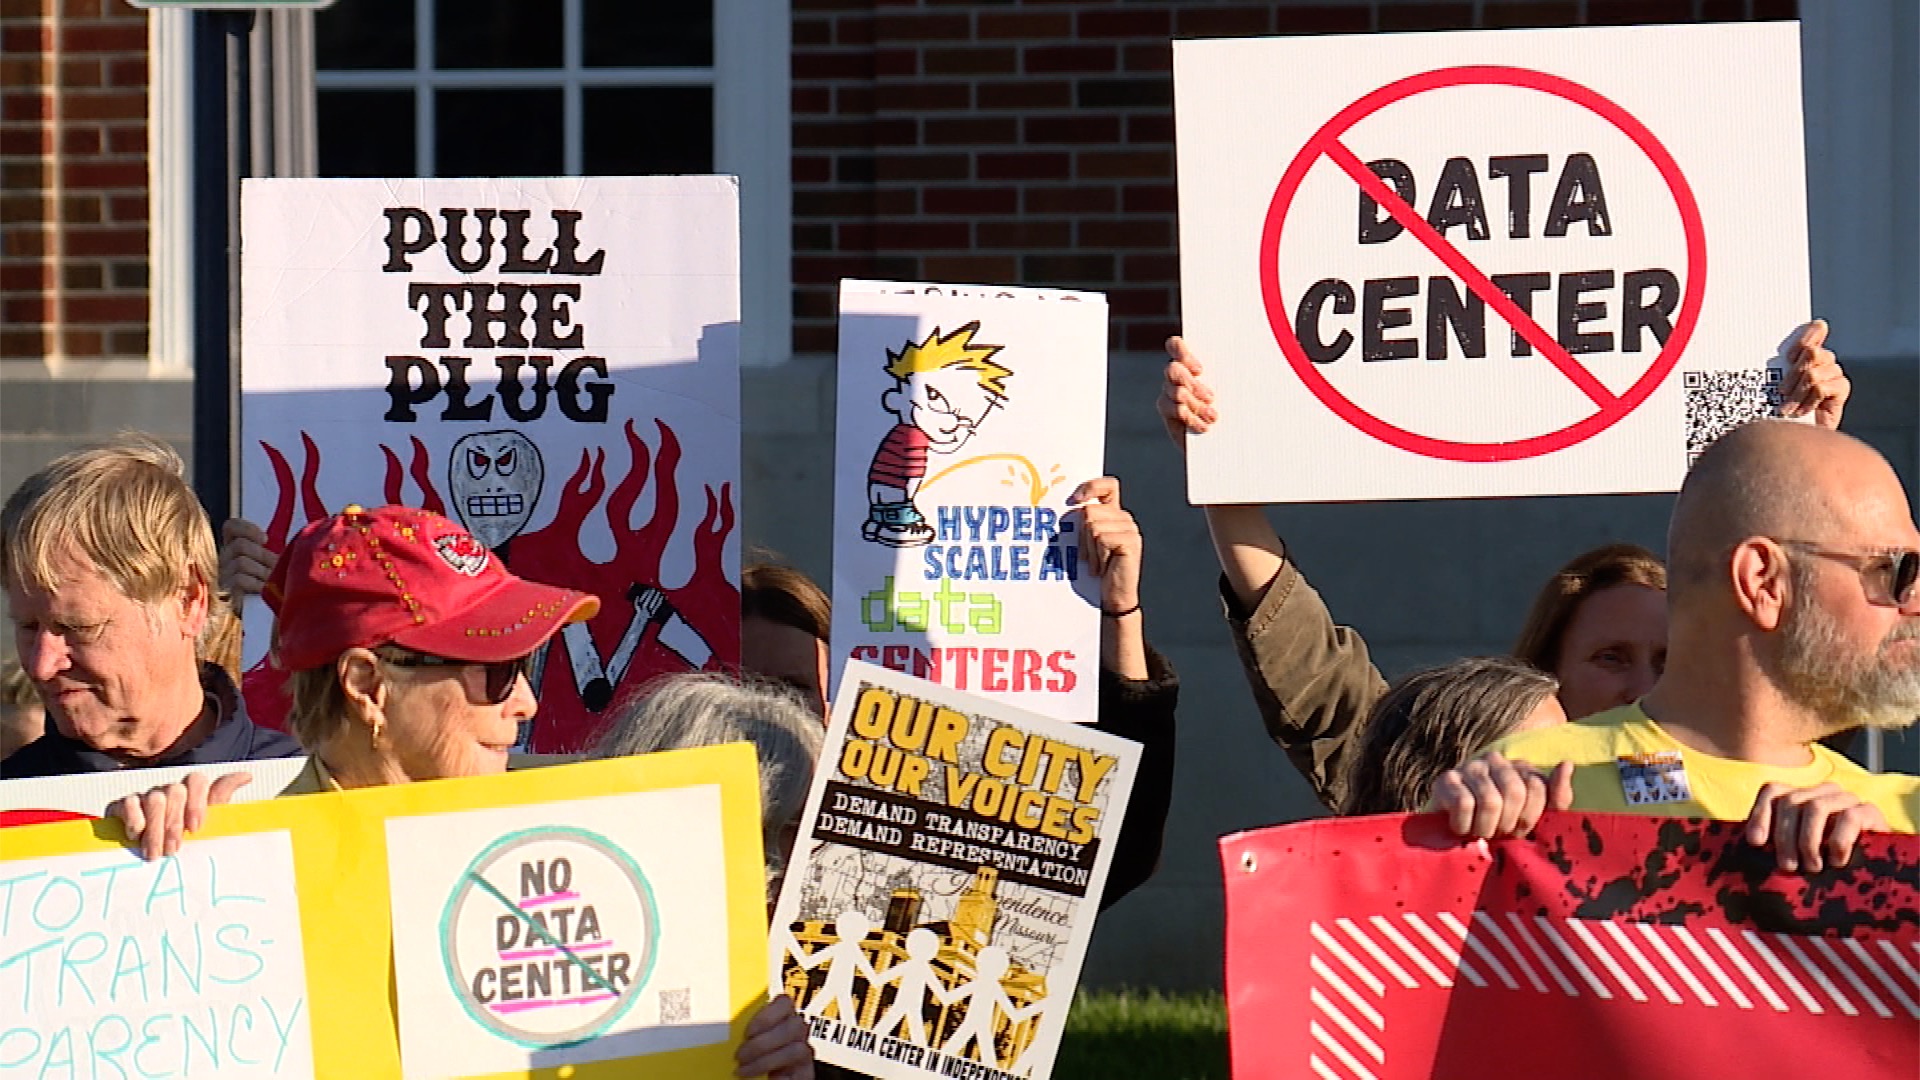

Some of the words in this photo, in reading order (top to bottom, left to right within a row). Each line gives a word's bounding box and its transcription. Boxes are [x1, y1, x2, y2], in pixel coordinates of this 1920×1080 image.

[1357, 152, 1613, 244] DATA
[382, 207, 606, 276] PULL
[408, 282, 585, 349] THE
[1295, 268, 1681, 364] CENTER
[384, 356, 615, 423] PLUG
[937, 505, 1074, 542] HYPER-
[923, 546, 1030, 580] SCALE
[1038, 546, 1078, 581] AI
[861, 575, 1002, 634] data
[853, 688, 969, 765] OUR
[983, 727, 1118, 805] CITY
[840, 739, 930, 796] OUR
[946, 765, 1102, 844] VOICES
[817, 812, 903, 845] DEMAND
[909, 832, 1089, 886] REPRESENTATION
[832, 792, 917, 825] DEMAND
[925, 812, 1084, 862] TRANSPARENCY
[0, 855, 266, 937] TOTAL
[520, 857, 572, 897] NO
[495, 905, 603, 951] DATA
[0, 922, 274, 1013] TRANS-
[472, 951, 631, 1004] CENTER
[831, 1023, 847, 1045] AI
[846, 1027, 877, 1054] DATA
[879, 1037, 925, 1068] CENTER
[925, 1049, 941, 1073] IN
